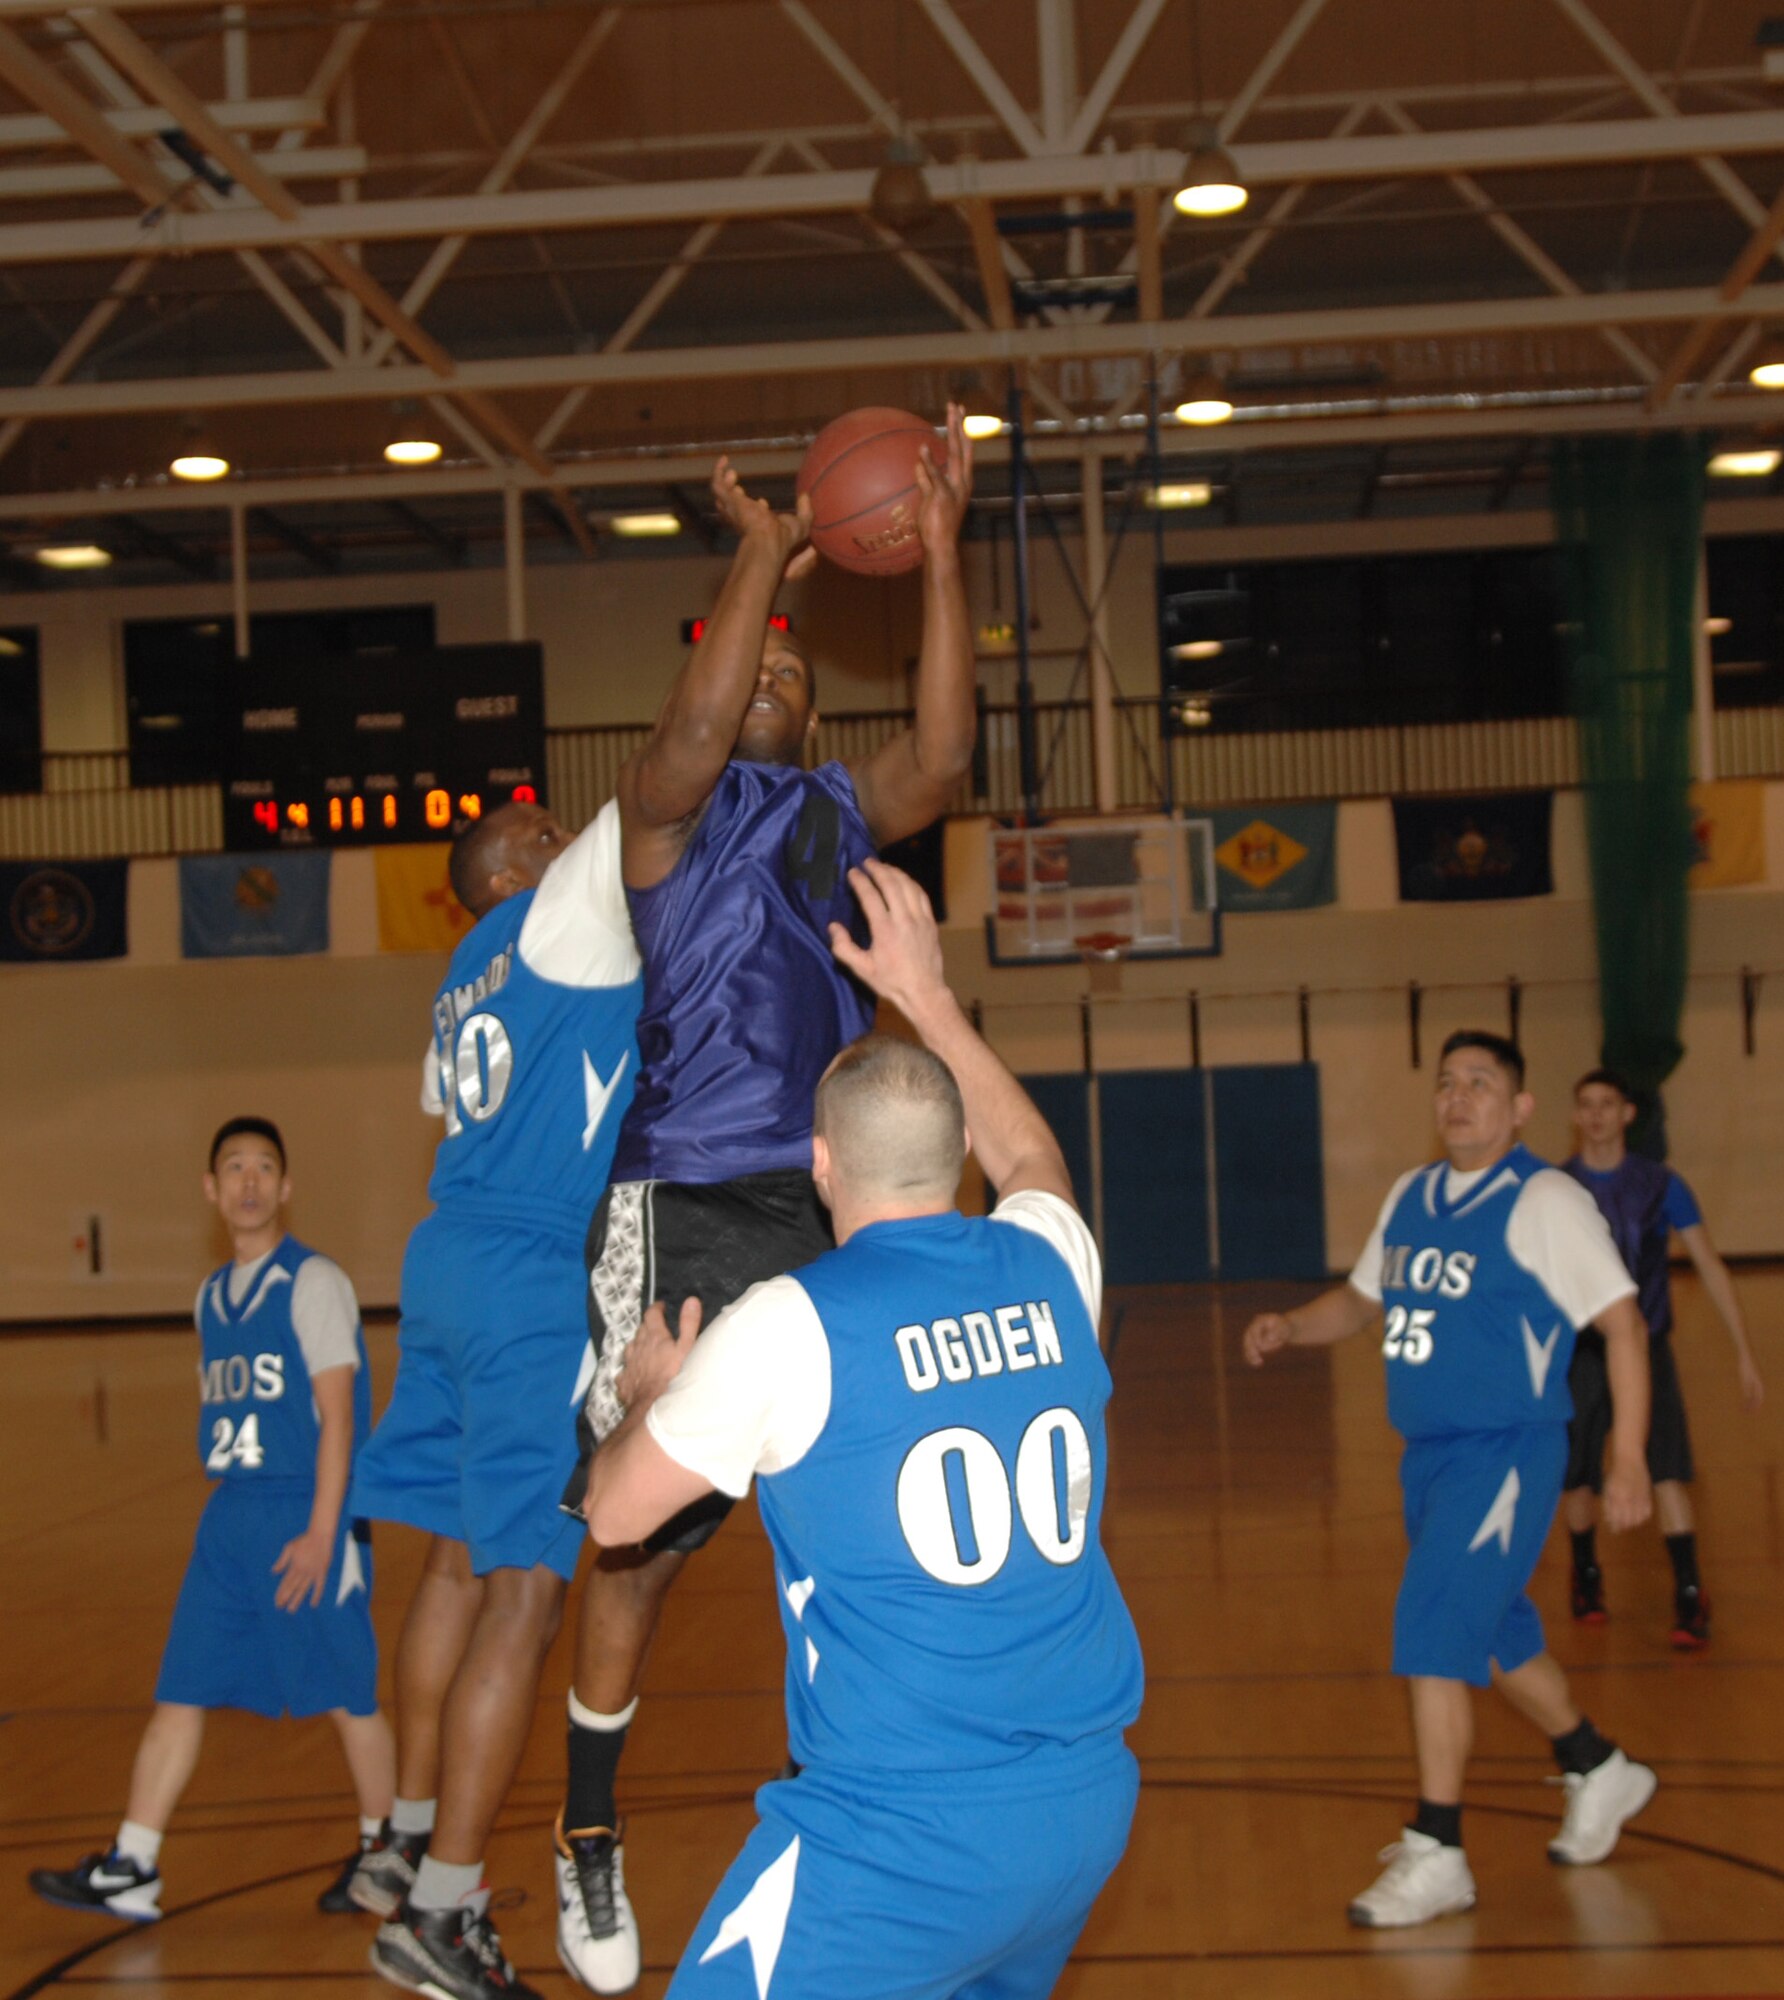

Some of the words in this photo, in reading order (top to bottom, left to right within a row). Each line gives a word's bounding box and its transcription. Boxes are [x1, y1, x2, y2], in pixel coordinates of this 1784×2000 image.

[243, 707, 298, 731] HOME
[455, 695, 519, 722] GUEST
[425, 788, 451, 829] 0
[785, 795, 841, 900] 4
[440, 1011, 513, 1137] 10
[1380, 1245, 1477, 1299] MOS
[894, 1299, 1064, 1393] OGDEN
[1382, 1304, 1437, 1364] 25
[200, 1353, 285, 1403] MOS
[206, 1412, 265, 1470] 24
[895, 1405, 1093, 1586] 00
